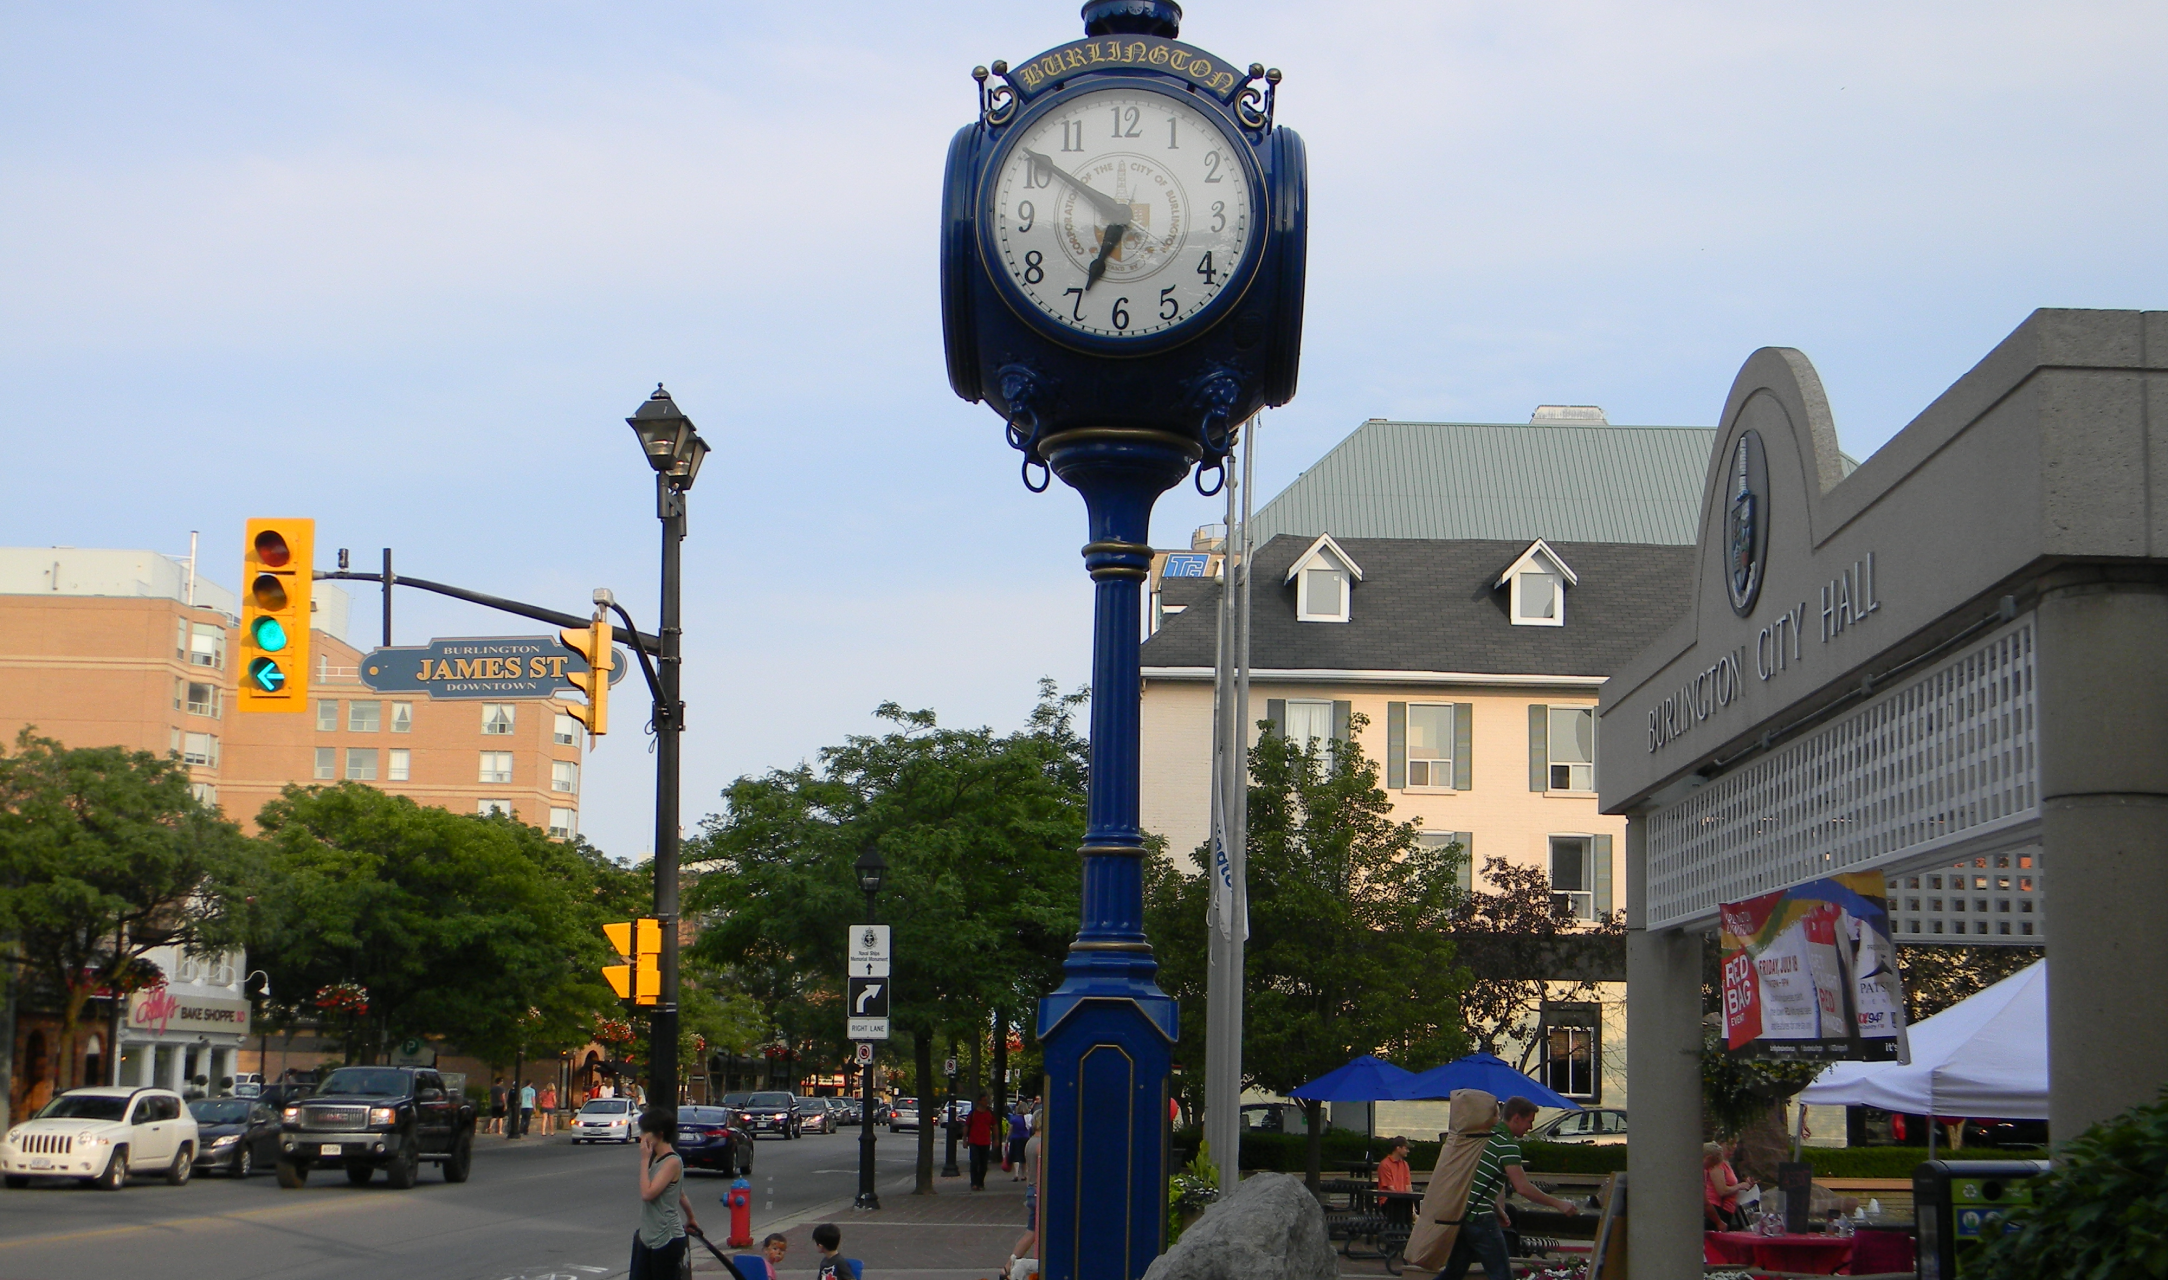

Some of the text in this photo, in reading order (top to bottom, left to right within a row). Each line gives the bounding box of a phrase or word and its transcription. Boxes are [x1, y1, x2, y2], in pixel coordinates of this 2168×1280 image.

[1020, 41, 1234, 94] BURLINGTON
[1060, 119, 1085, 152] 11
[1110, 106, 1143, 138] 12
[1166, 117, 1180, 149] 1
[1023, 156, 1053, 189] 10
[1094, 163, 1114, 175] THE
[1131, 163, 1153, 176] CITY
[1154, 175, 1168, 187] OF
[1204, 150, 1224, 183] 2
[1017, 200, 1035, 233] 9
[1210, 200, 1226, 233] 3
[1024, 250, 1044, 284] 8
[1196, 250, 1217, 285] 4
[1063, 287, 1088, 322] 7
[1111, 297, 1130, 330] 6
[1159, 284, 1179, 320] 5
[443, 645, 540, 655] BURLINGTON
[1648, 551, 1881, 754] BURLINGTON CITY HALL
[415, 656, 569, 681] JAMES ST
[446, 681, 537, 692] DOWNTOWN
[1725, 954, 1749, 988] RED
[1727, 980, 1751, 1014] BAG
[181, 1007, 203, 1020] BAKE
[204, 1008, 235, 1022] SHOPPE
